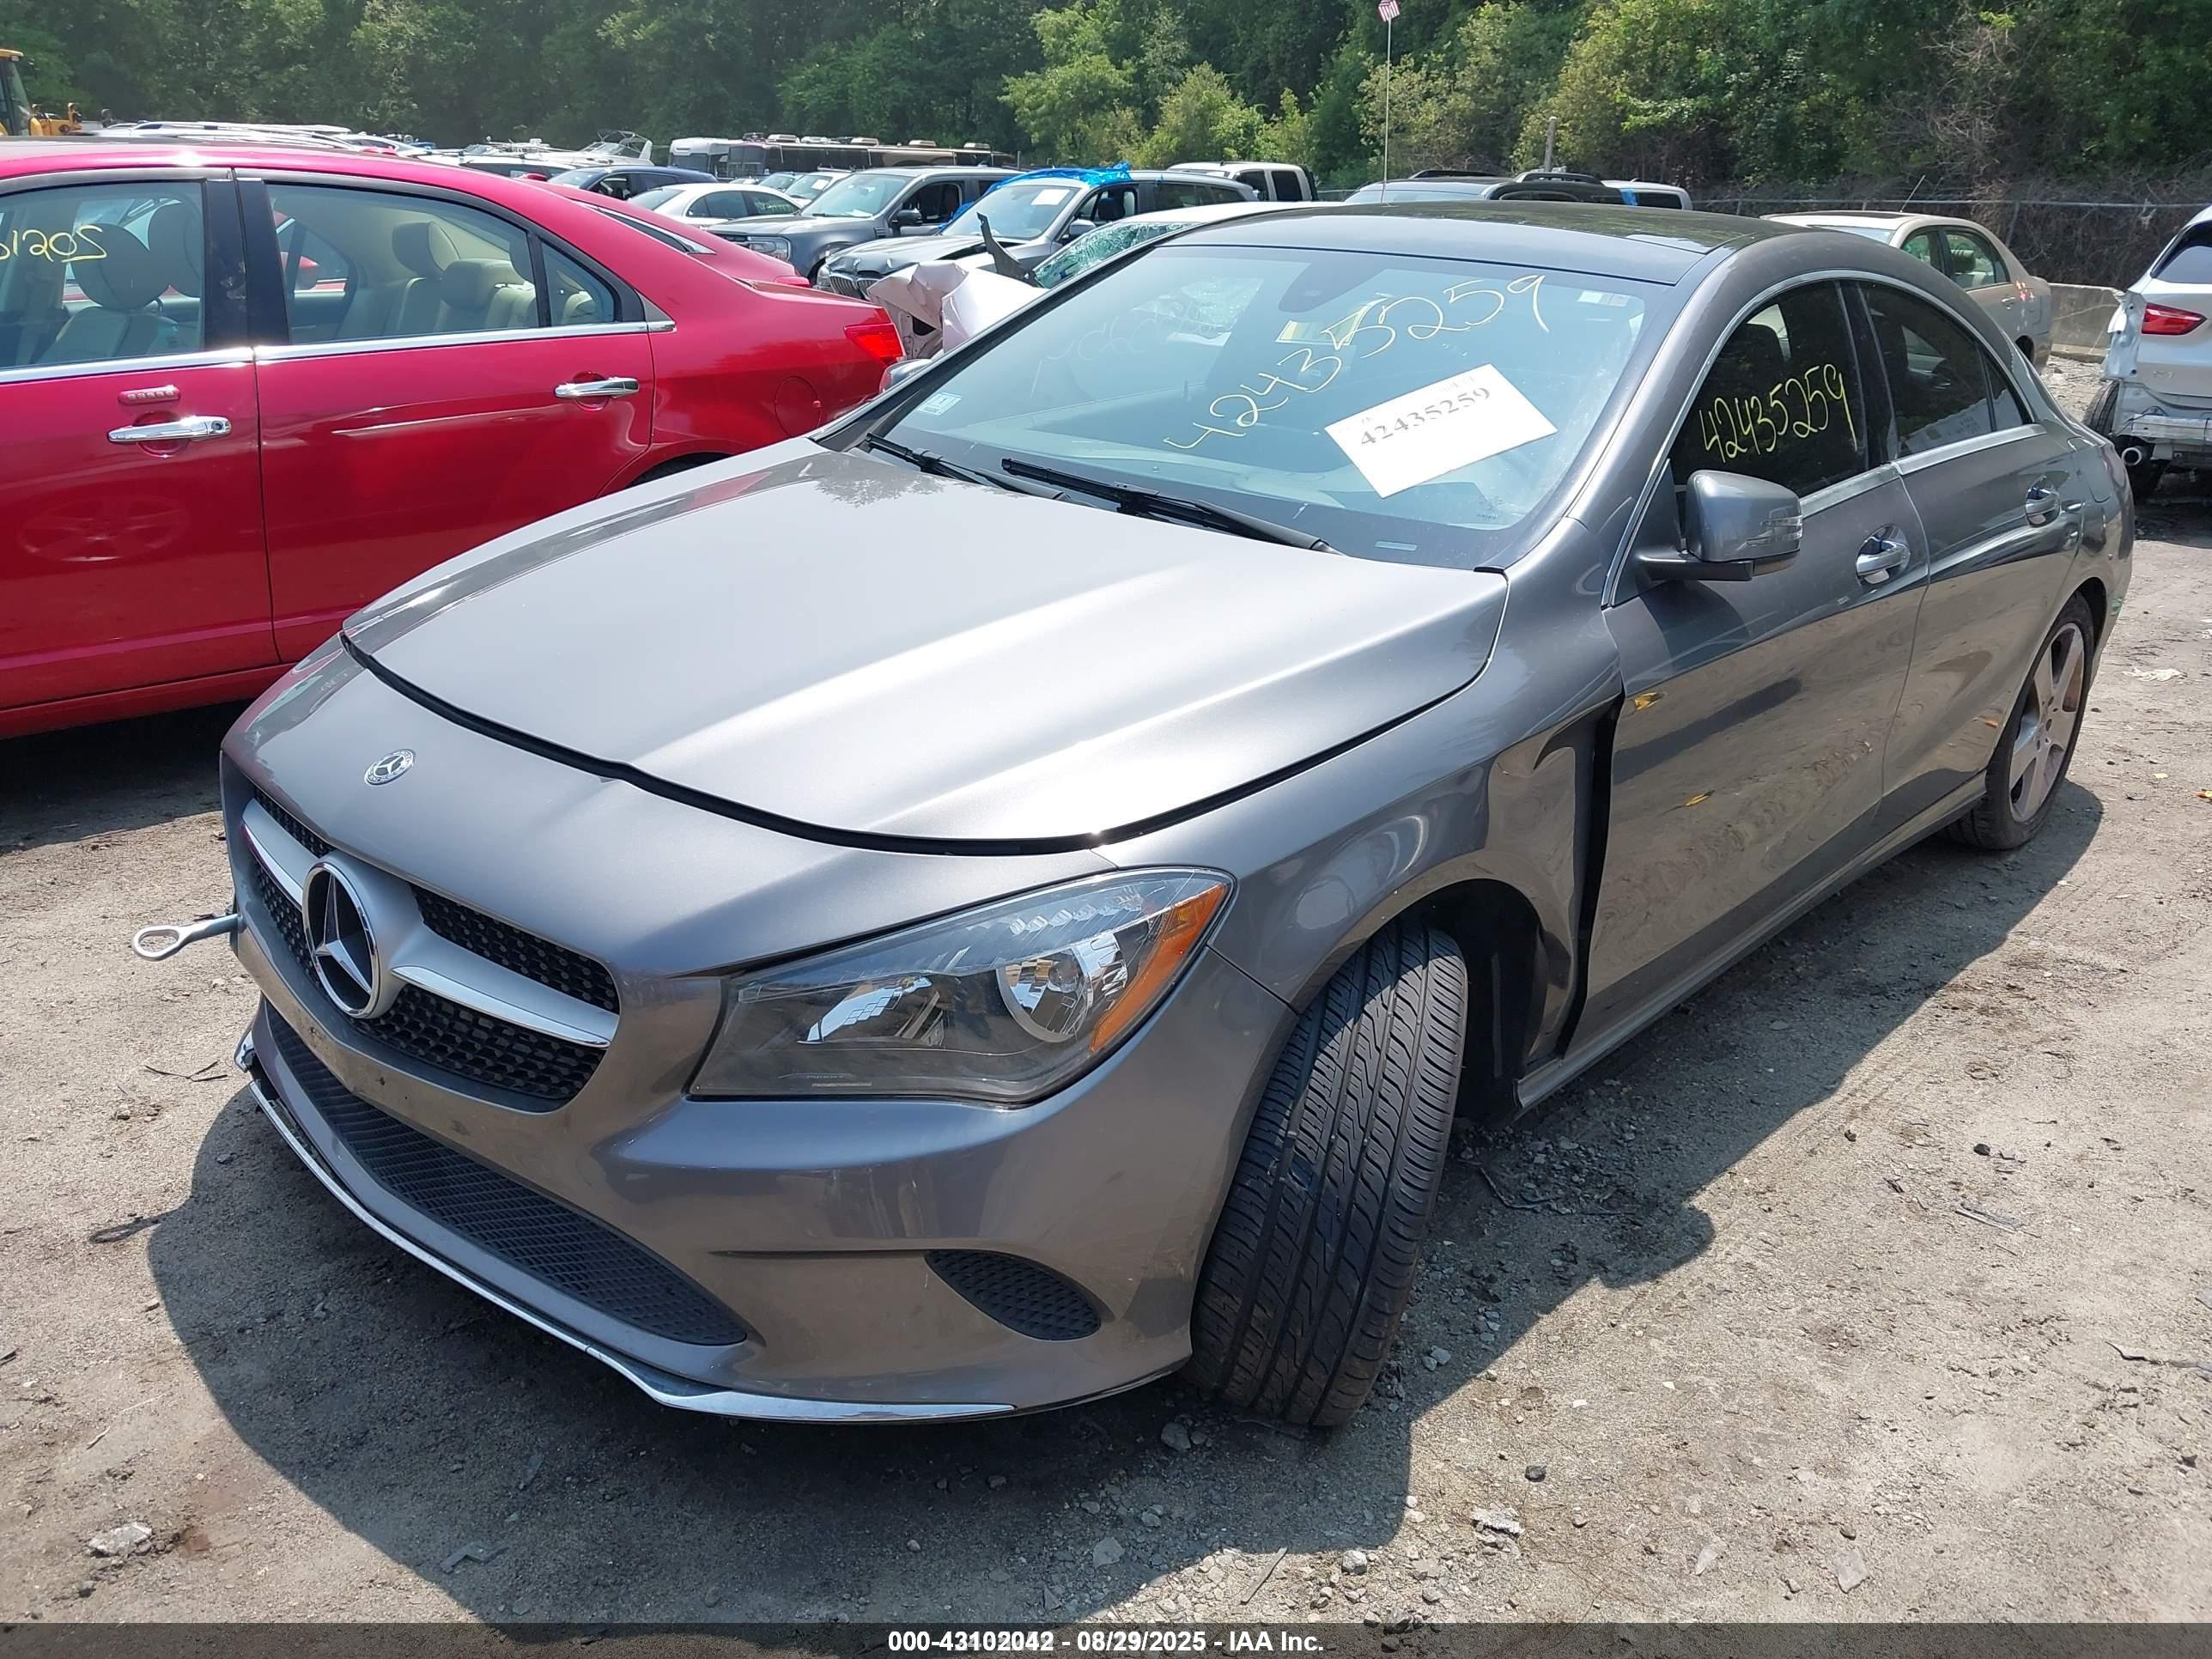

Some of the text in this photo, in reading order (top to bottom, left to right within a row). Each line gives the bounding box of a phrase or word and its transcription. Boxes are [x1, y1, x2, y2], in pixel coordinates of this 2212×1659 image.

[1163, 275, 1551, 449] 42435259
[1360, 386, 1492, 447] 42435259
[1699, 363, 1858, 463] 42435259
